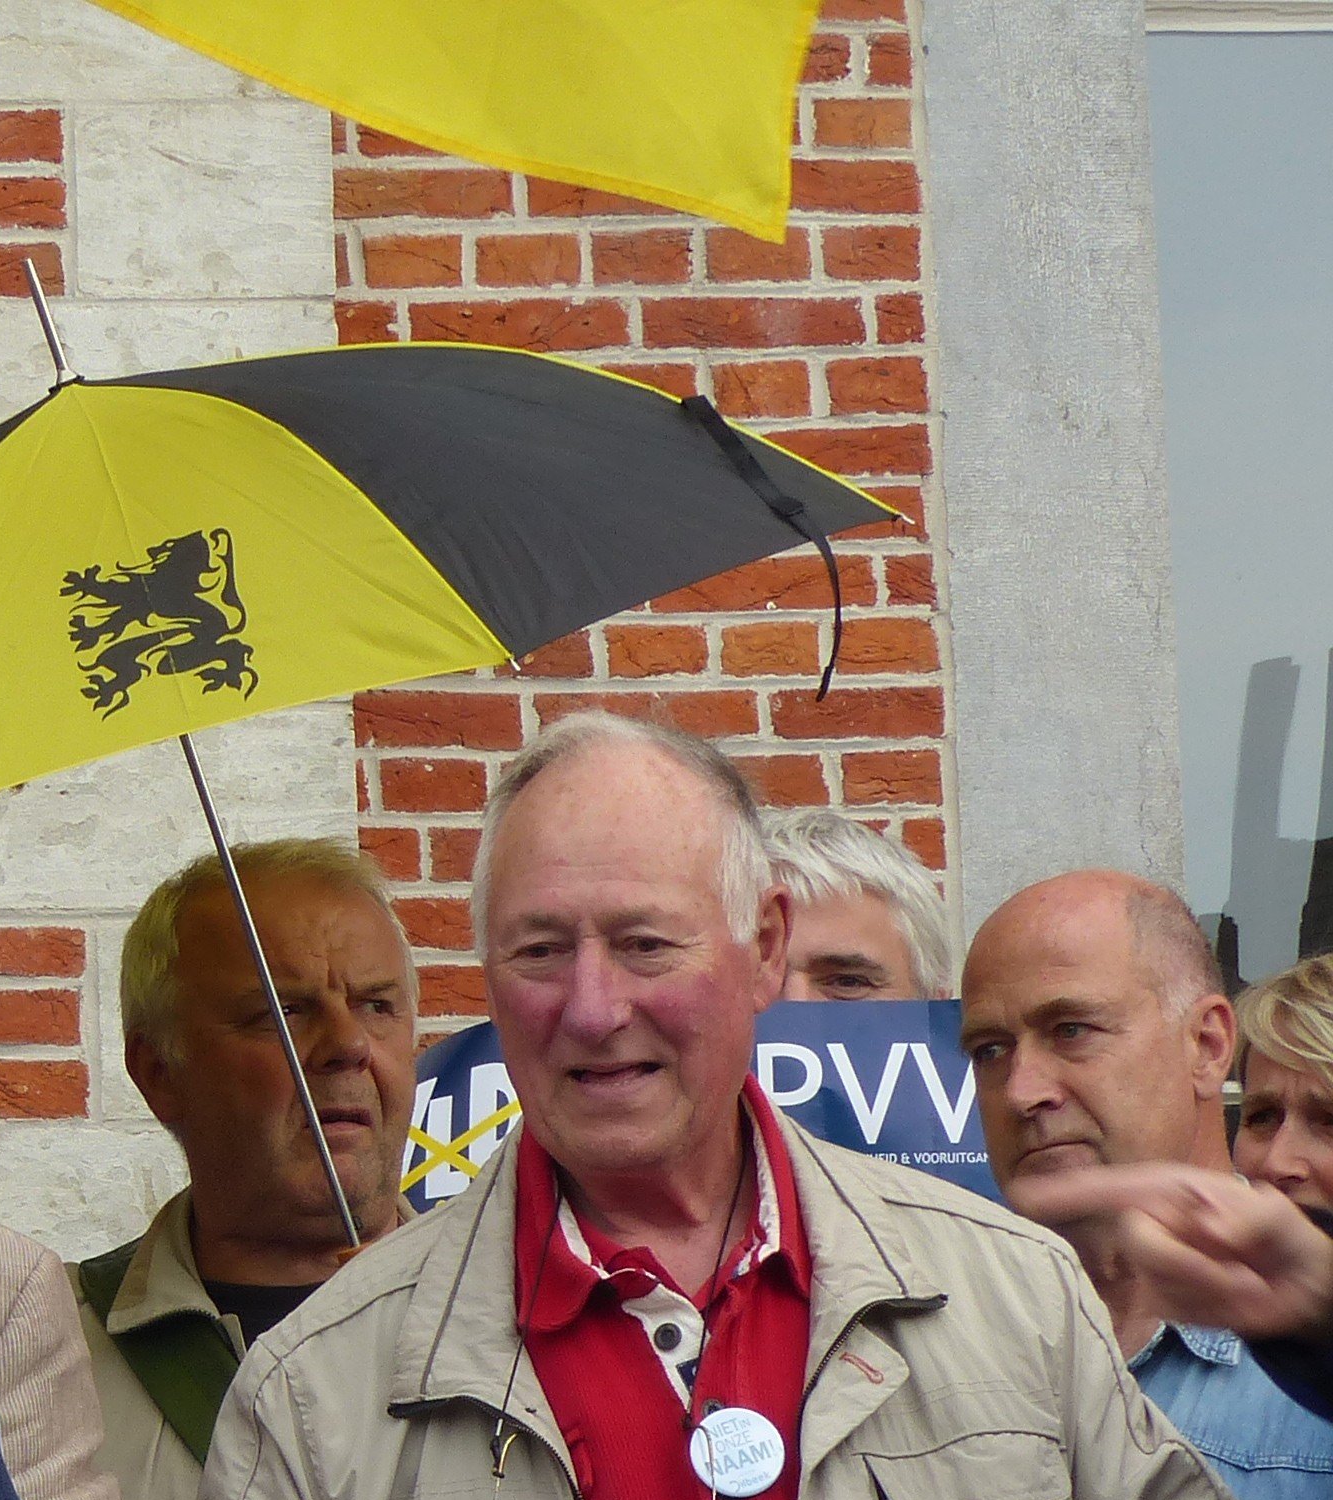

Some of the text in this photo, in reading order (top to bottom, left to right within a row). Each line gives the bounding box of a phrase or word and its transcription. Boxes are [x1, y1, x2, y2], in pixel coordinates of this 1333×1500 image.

[757, 1042, 976, 1144] PVV
[707, 1418, 751, 1439] NIET IN
[714, 1430, 753, 1453] ONZE
[705, 1439, 776, 1476] NAAM!
